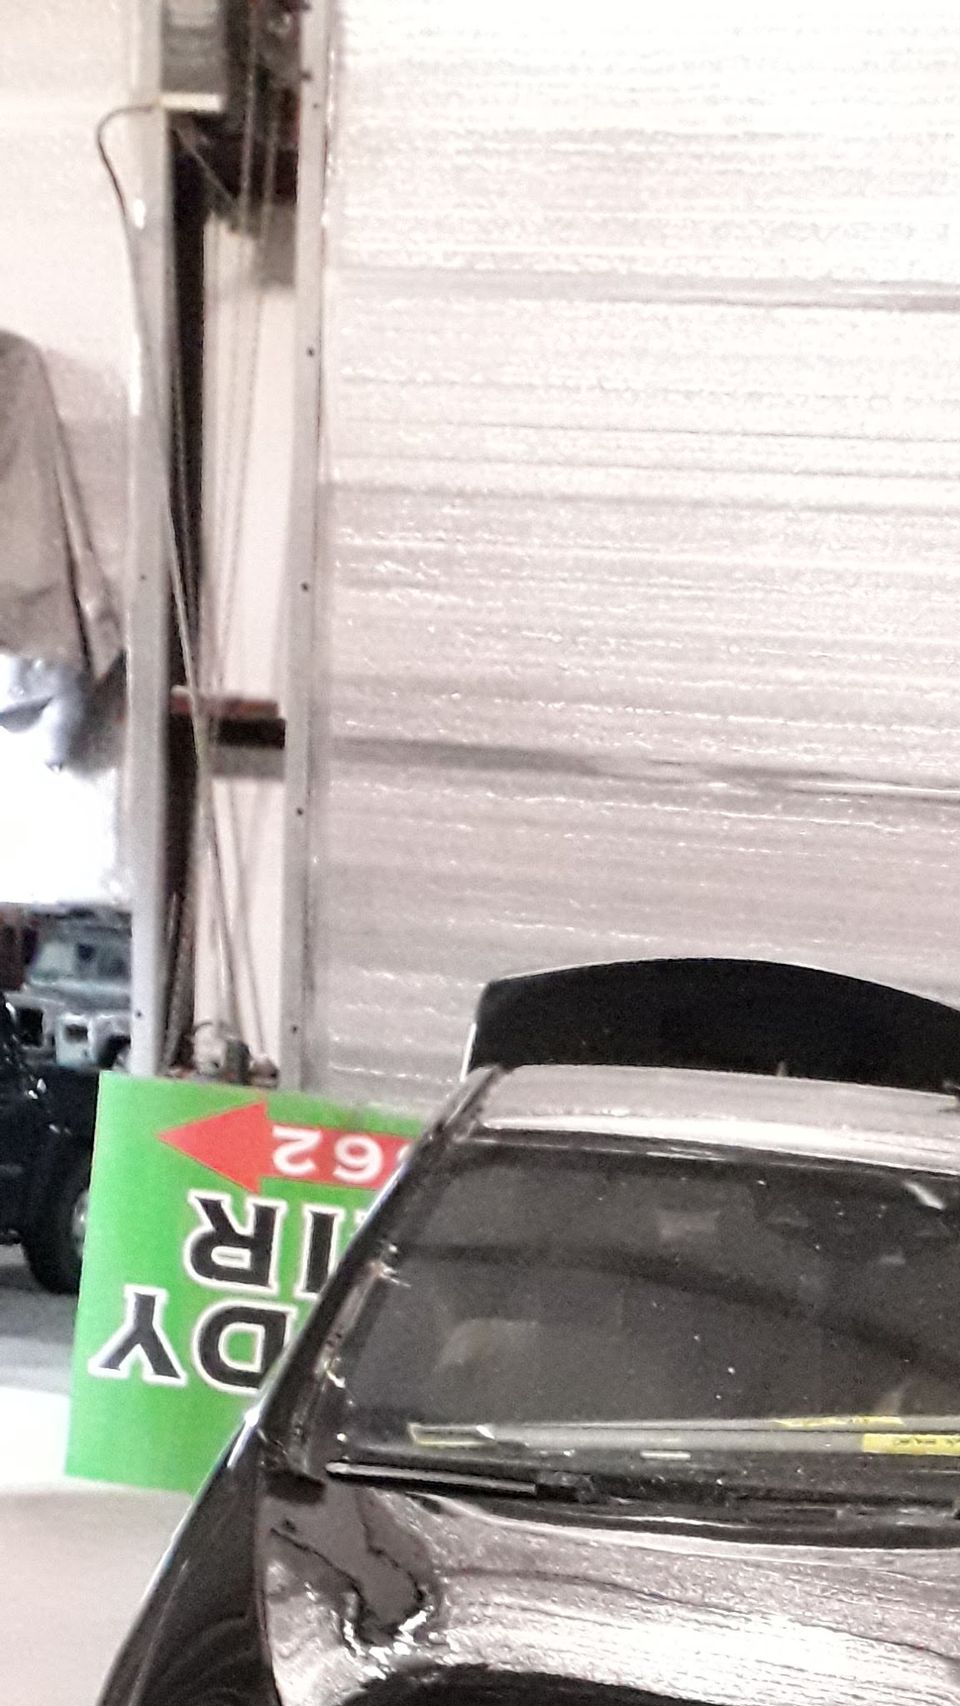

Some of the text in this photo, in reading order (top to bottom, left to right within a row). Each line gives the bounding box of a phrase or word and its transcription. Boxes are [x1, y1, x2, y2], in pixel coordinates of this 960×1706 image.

[272, 1126, 409, 1181] 62
[184, 1190, 367, 1298] IR
[89, 1286, 297, 1393] DY
